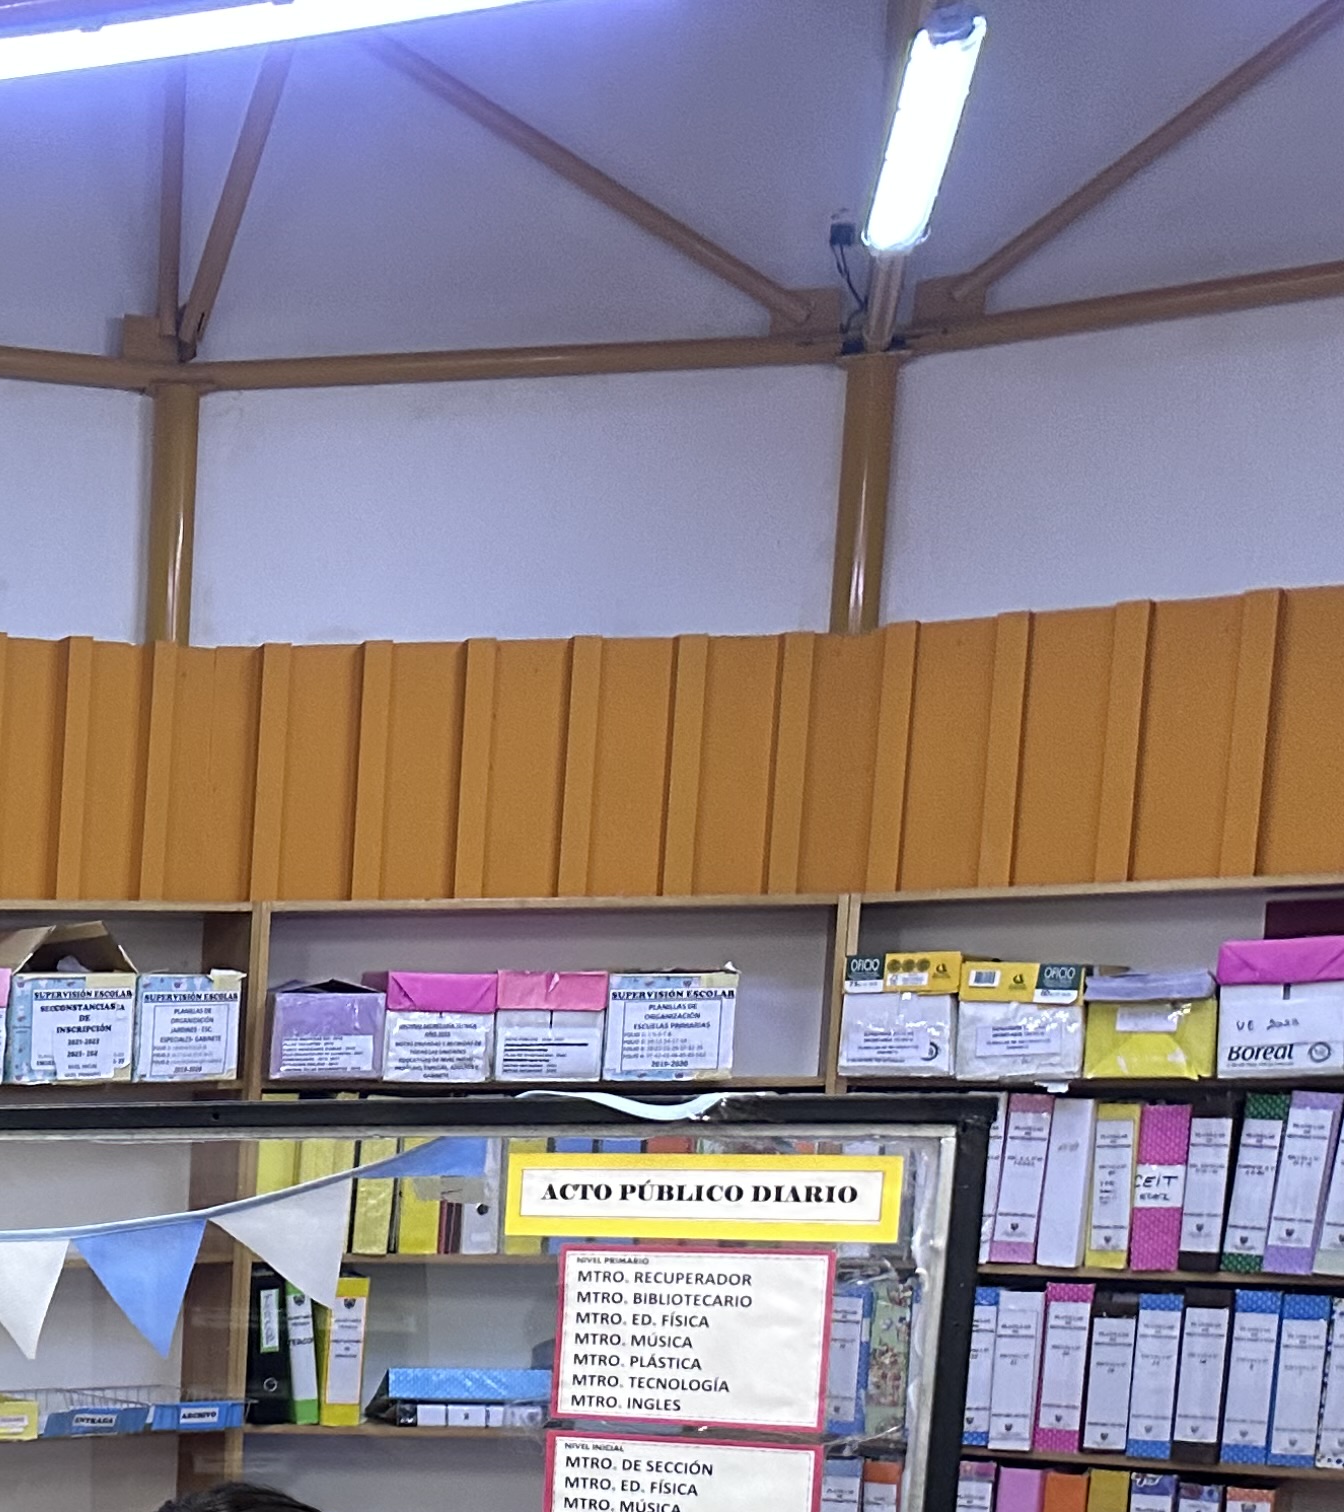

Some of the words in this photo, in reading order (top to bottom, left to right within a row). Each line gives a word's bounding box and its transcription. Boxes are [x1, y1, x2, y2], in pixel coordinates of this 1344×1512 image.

[34, 989, 92, 1000] SUPERVISIÓN
[144, 992, 202, 1002] SUPERVISIÓN
[611, 989, 684, 1000] SUPERVISIÓN
[686, 989, 735, 999] ESCOLAR
[541, 1183, 612, 1200] ACTO
[619, 1180, 744, 1202] PÚBLICO
[750, 1185, 858, 1204] DIARIO
[576, 1256, 602, 1264] NIVEL
[604, 1257, 649, 1265] PRIMARIO
[577, 1270, 629, 1283] MTRO.
[634, 1271, 752, 1286] RECUPERADOR
[576, 1291, 628, 1305] MTRO.
[633, 1292, 753, 1308] BIBLIOTECARIO
[575, 1312, 627, 1325] MTRO.
[632, 1314, 657, 1326] ED.
[661, 1311, 710, 1328] FÍSICA
[574, 1333, 626, 1346] MTRO.
[630, 1332, 693, 1349] MÚSICA
[573, 1353, 625, 1367] MTRO.
[629, 1353, 702, 1371] PLÁSTICA
[572, 1374, 624, 1388] MTRO.
[628, 1376, 730, 1393] TECNOLOGÍA
[571, 1394, 622, 1409] MTRO.
[627, 1397, 681, 1411] INGLES
[564, 1442, 590, 1450] NIVEL
[592, 1444, 624, 1452] INICIAL
[565, 1456, 617, 1470] MTRO.
[622, 1459, 642, 1471] DE
[646, 1460, 713, 1476] SECCIÓN
[564, 1476, 616, 1491] MTRO.
[621, 1480, 645, 1493] ED.
[650, 1480, 698, 1496] FÍSICA
[564, 1497, 615, 1512] MTRO.
